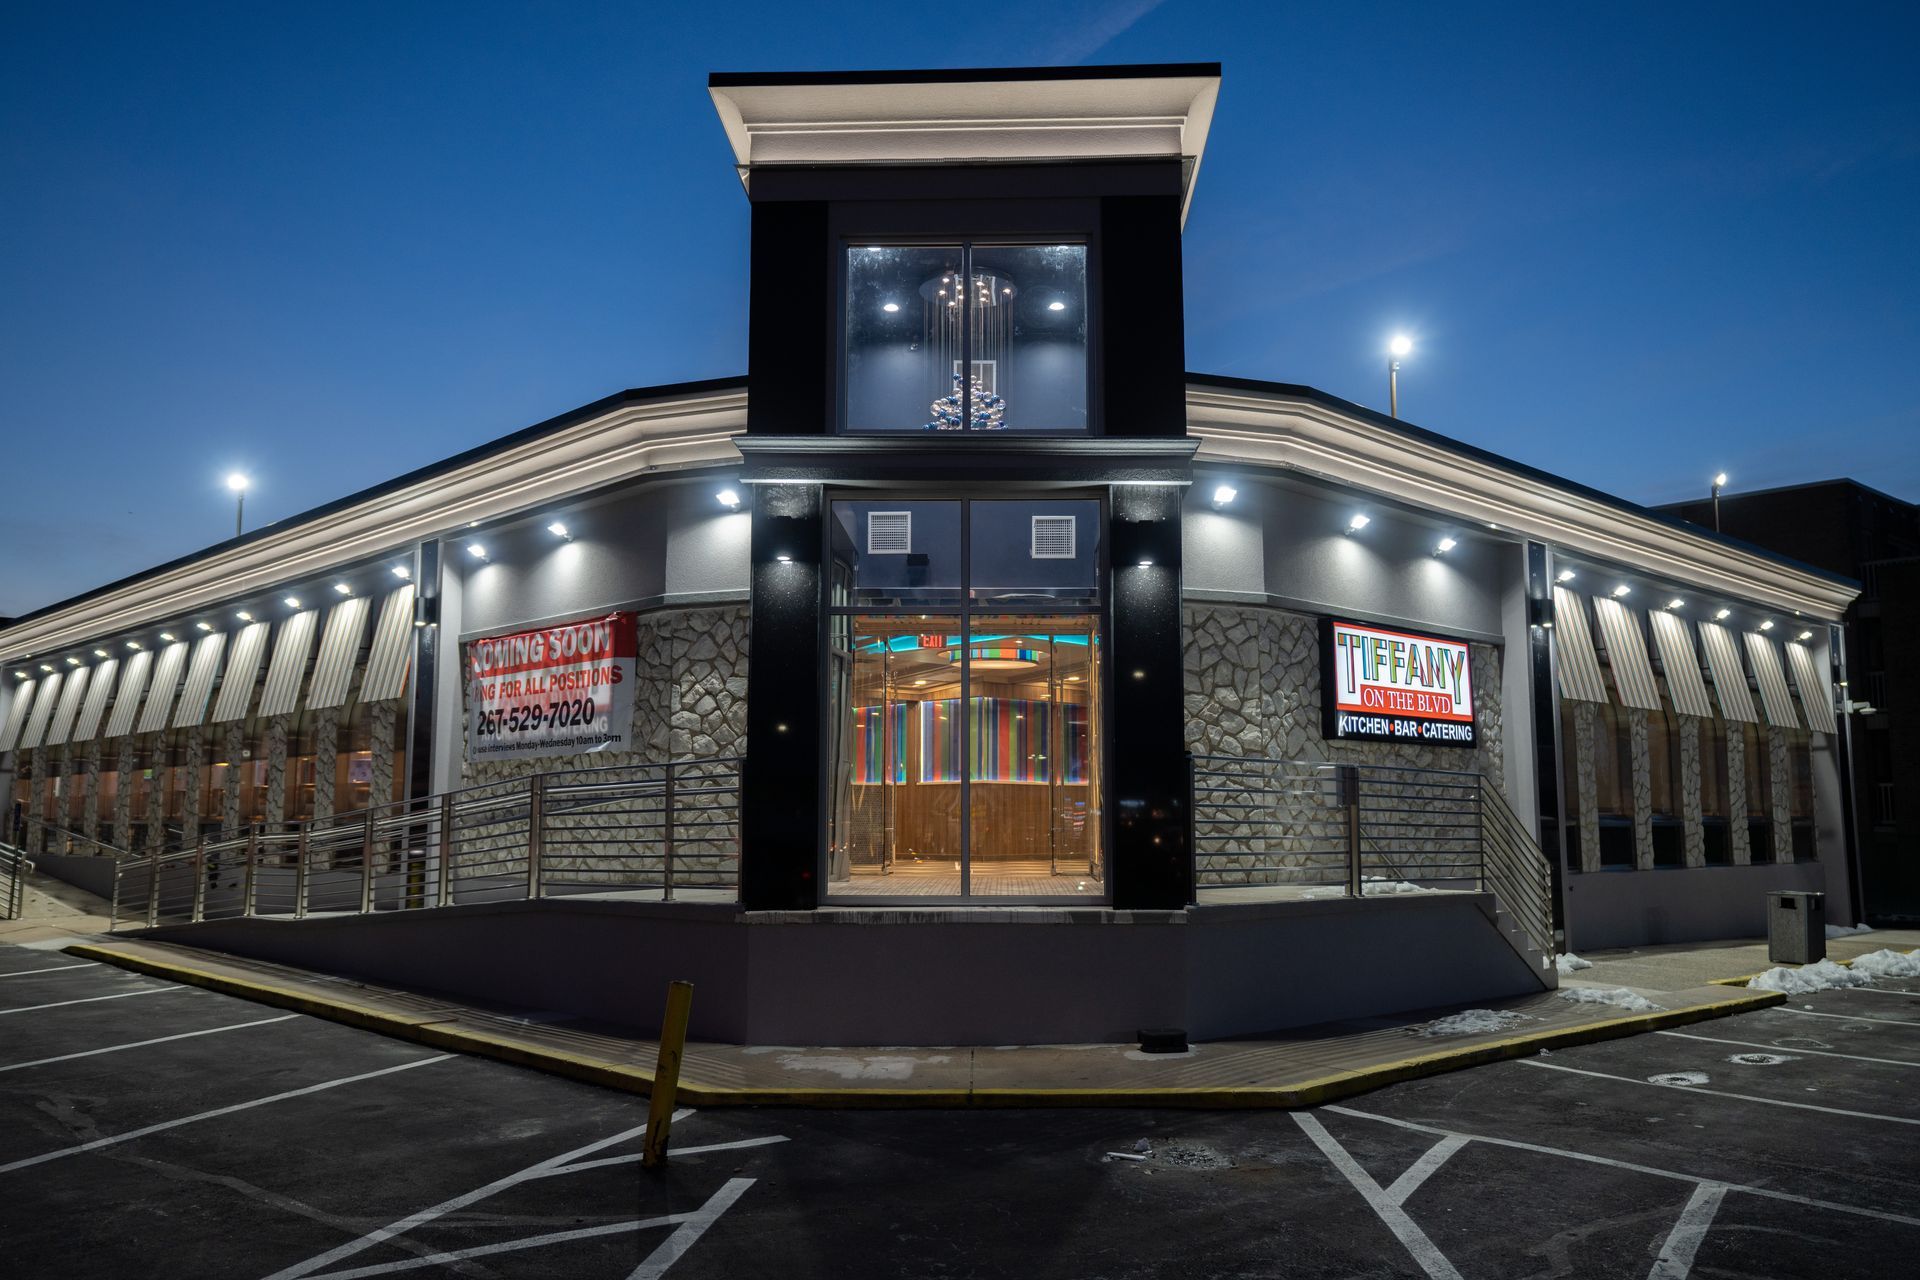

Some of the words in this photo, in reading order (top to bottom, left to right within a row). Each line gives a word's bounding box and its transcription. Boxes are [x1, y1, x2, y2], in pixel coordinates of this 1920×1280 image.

[549, 622, 610, 660] SOON
[923, 635, 942, 647] EXIT
[499, 680, 522, 699] FOR
[525, 676, 546, 696] ALL
[550, 665, 623, 692] POSITIONS
[1337, 632, 1466, 704] TIFFANY
[1363, 687, 1385, 708] ON
[1387, 690, 1415, 712] THE
[1418, 693, 1451, 714] BLVD
[477, 697, 595, 736] 267-529-7020
[1338, 715, 1389, 737] KITCHEN
[1394, 721, 1418, 738] BAR
[1422, 722, 1473, 741] CATERING
[516, 736, 575, 751] Monday-Wednesday
[576, 735, 594, 746] 10am
[595, 735, 602, 744] to
